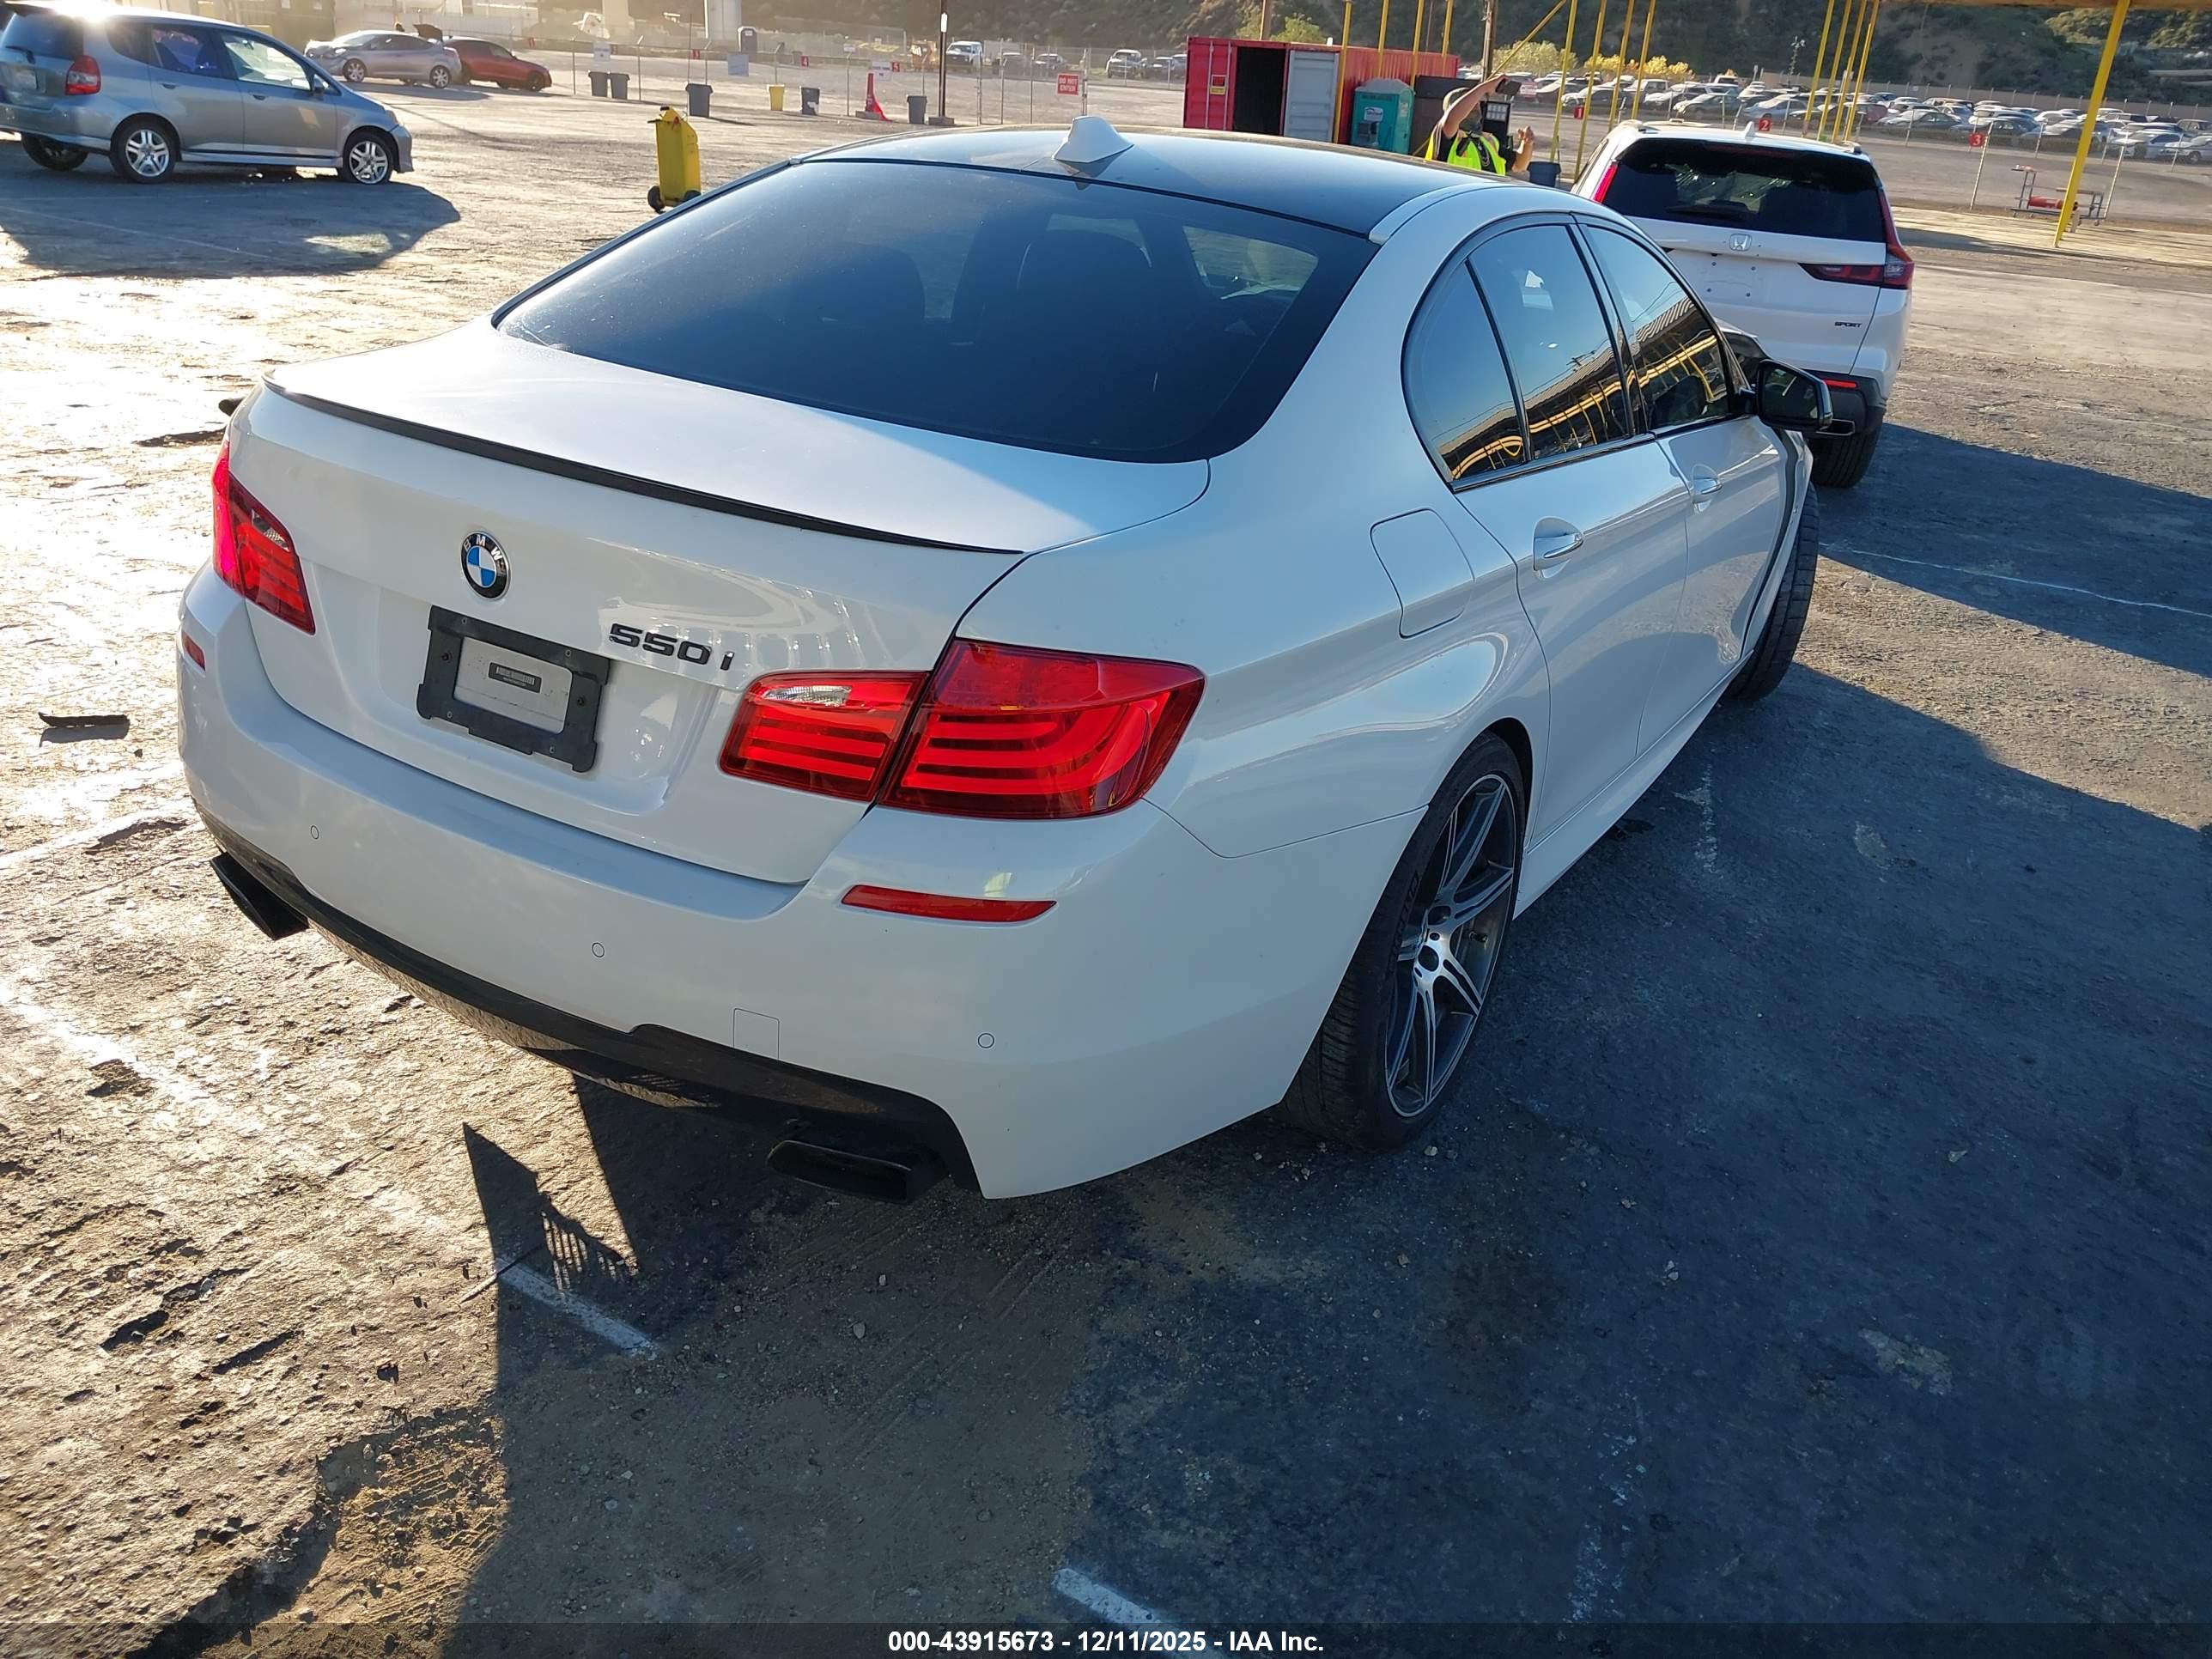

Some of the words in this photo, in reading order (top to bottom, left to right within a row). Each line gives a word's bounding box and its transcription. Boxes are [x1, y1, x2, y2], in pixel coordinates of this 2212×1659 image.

[1761, 119, 1769, 131] 2
[1972, 134, 1981, 146] 3
[463, 534, 503, 561] BMW
